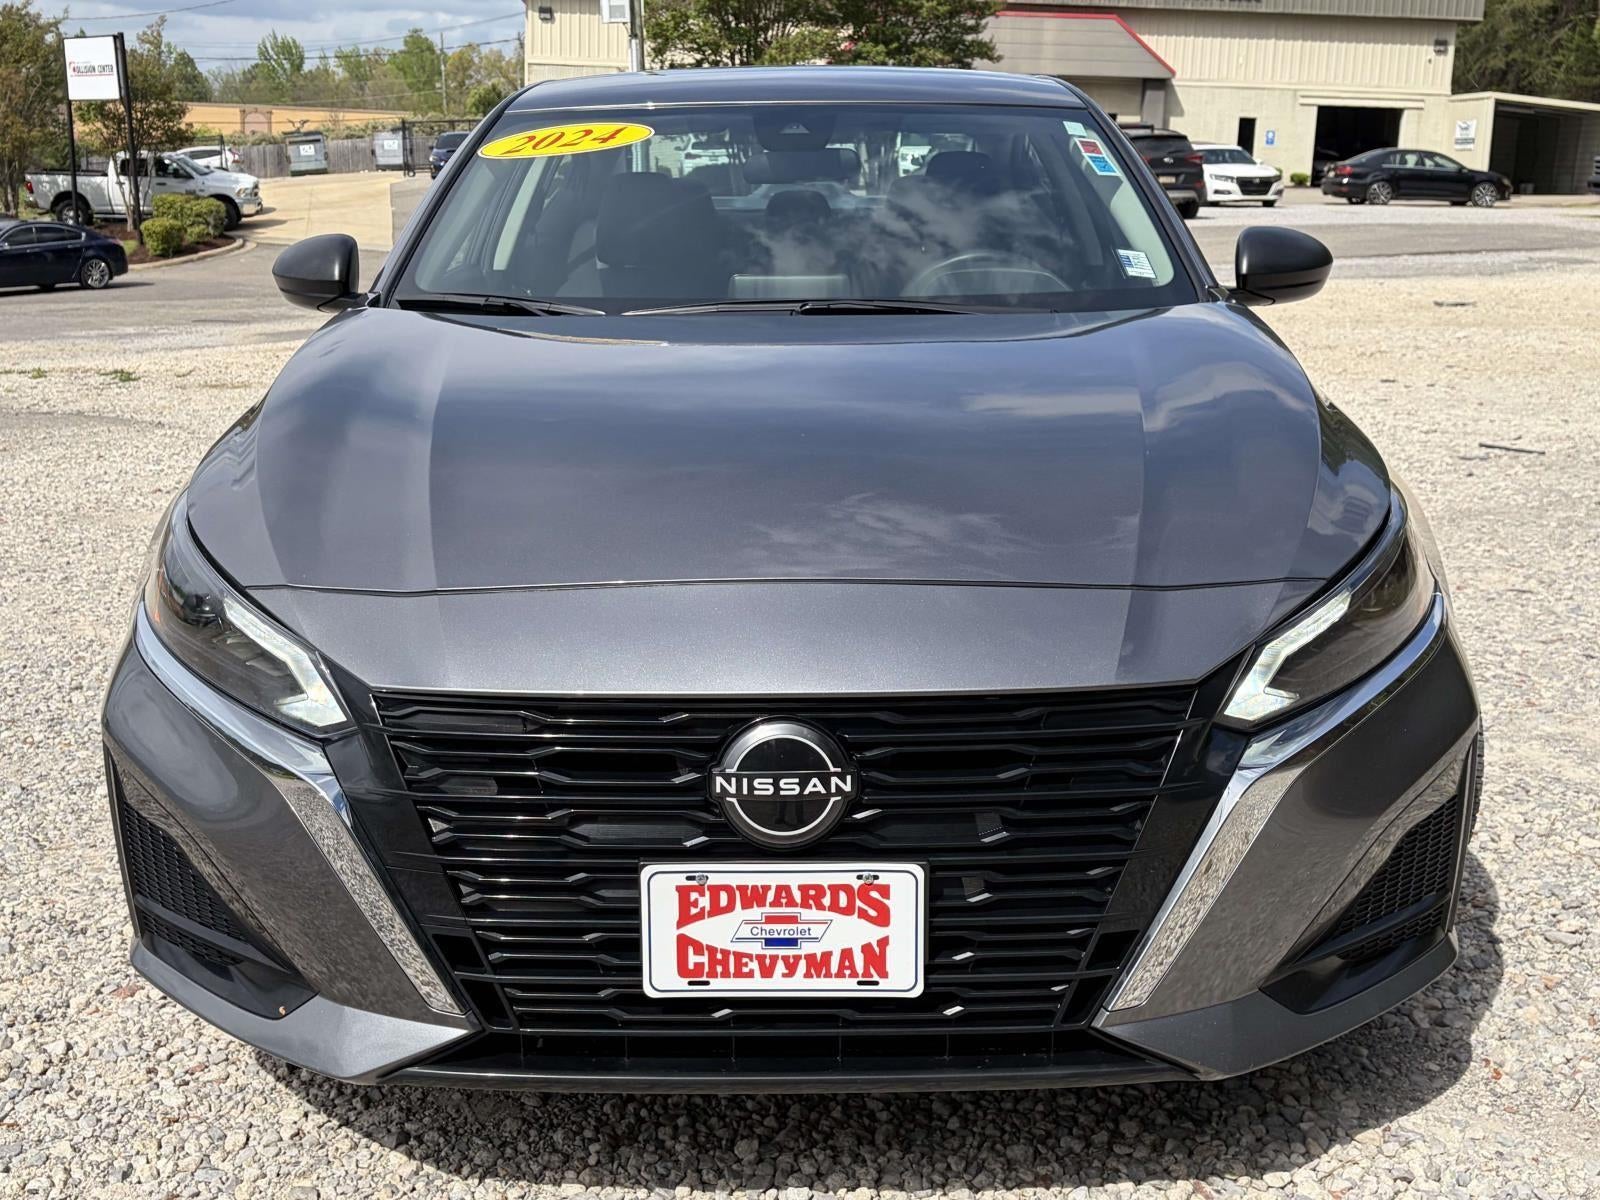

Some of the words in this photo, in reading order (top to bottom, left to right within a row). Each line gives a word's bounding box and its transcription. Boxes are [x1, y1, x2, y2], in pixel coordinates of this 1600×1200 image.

[97, 64, 114, 73] CENTER
[501, 126, 628, 155] 2024
[715, 775, 852, 795] NISSAN
[676, 884, 890, 929] EDWARDS
[750, 926, 812, 936] Chevrolet
[676, 933, 889, 978] CHEVYMAN
